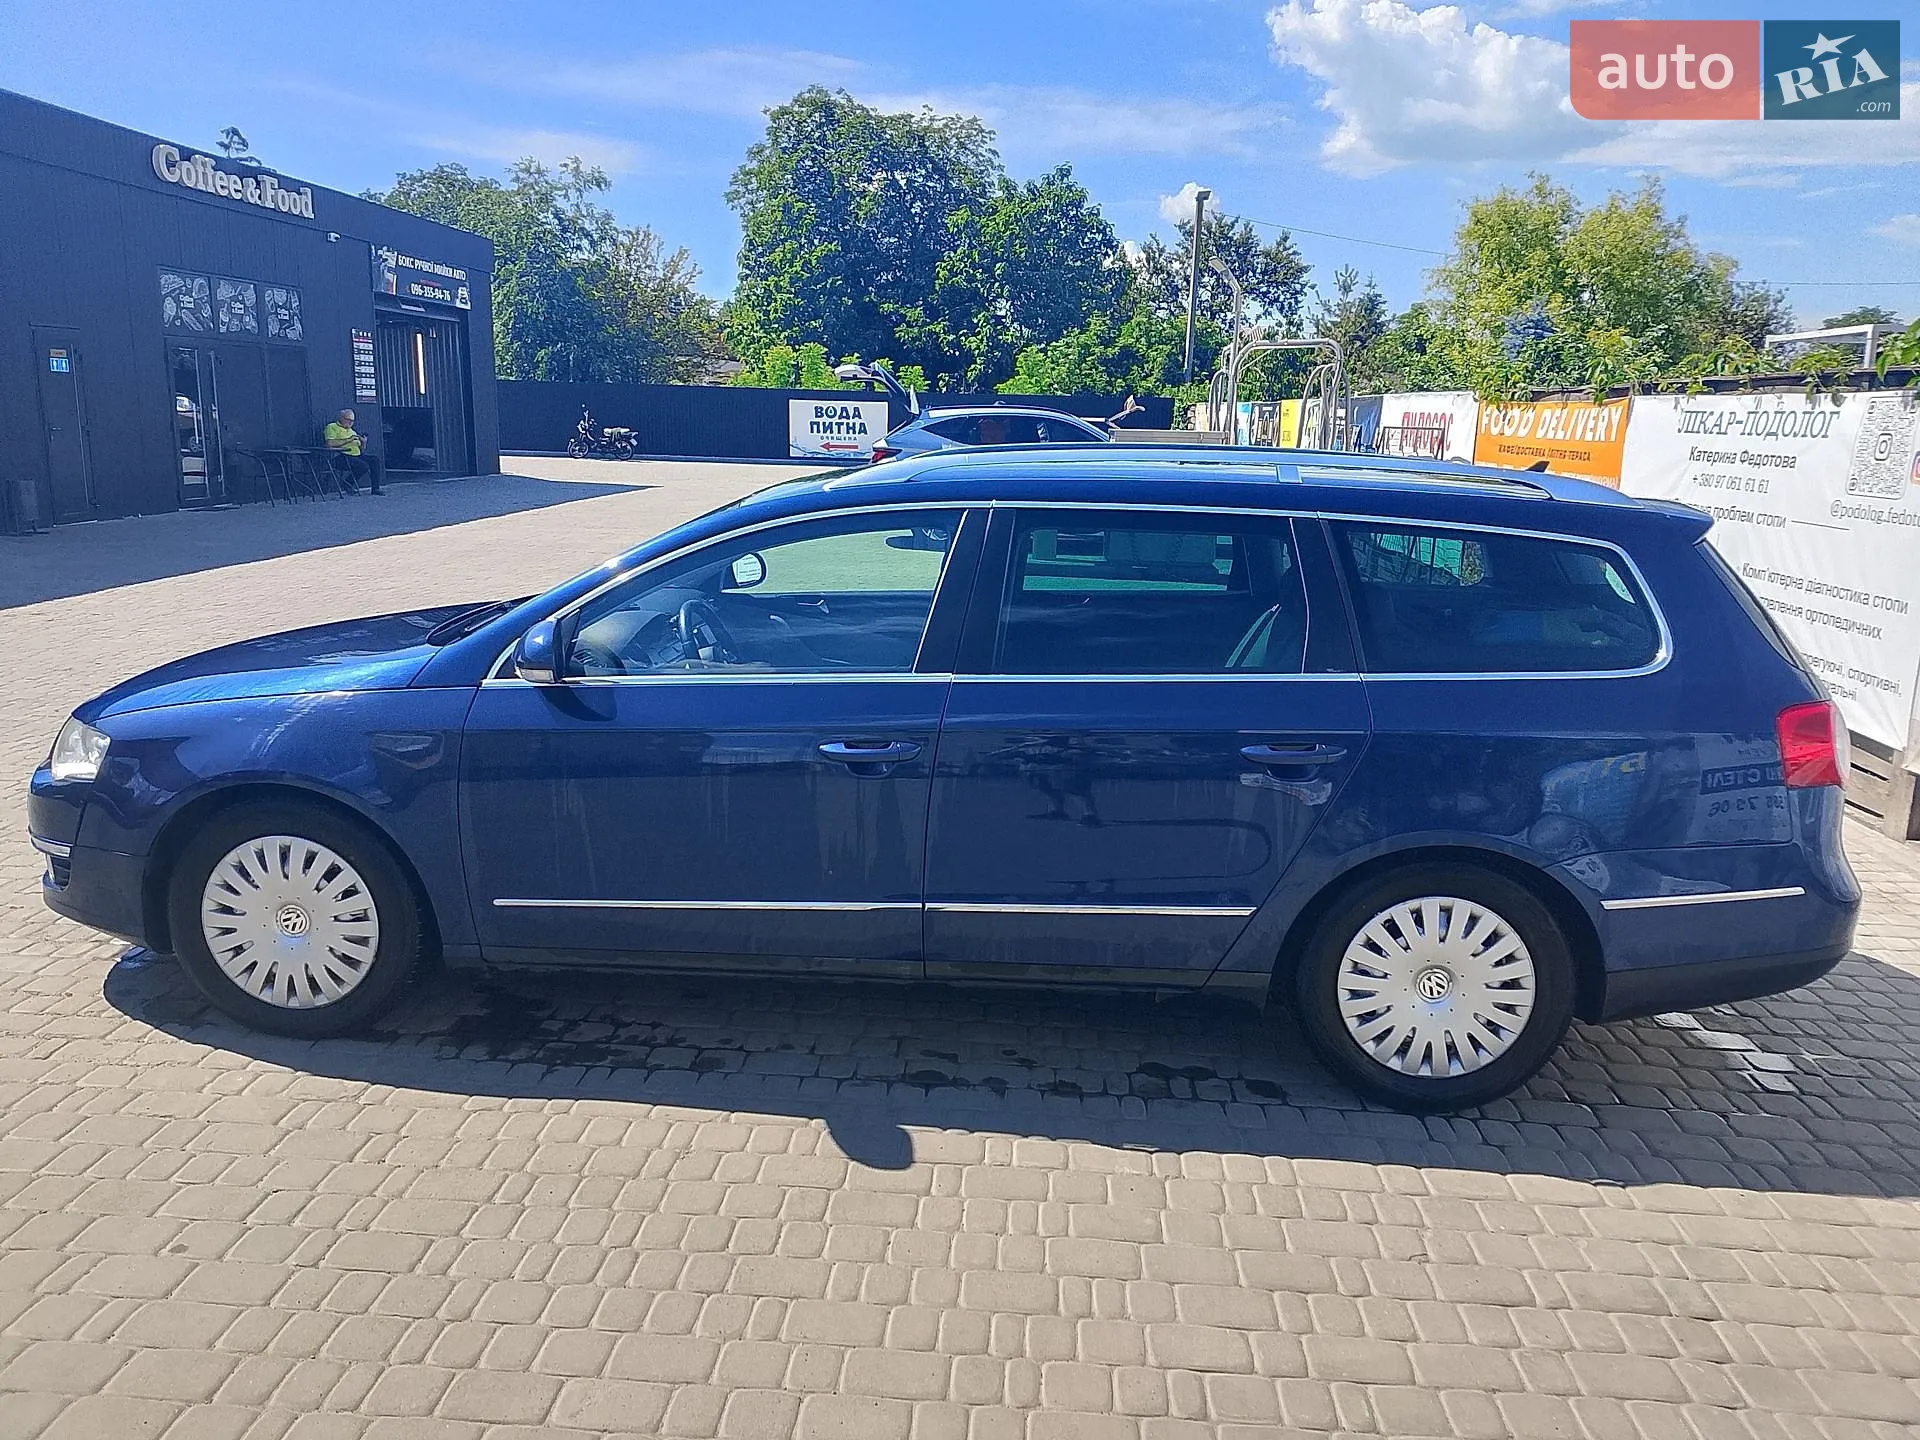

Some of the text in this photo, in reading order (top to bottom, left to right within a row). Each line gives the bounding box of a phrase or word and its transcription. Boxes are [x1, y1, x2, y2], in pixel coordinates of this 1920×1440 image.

[398, 254, 414, 268] БОКС
[813, 405, 862, 420] ВОДА
[1480, 405, 1624, 442] FOOD DELIVERY
[809, 421, 868, 435] ПИТНА
[1689, 446, 1797, 469] Катерина Федотова
[1745, 478, 1756, 492] 61
[1758, 479, 1769, 493] 61
[1713, 505, 1754, 523] проблем
[1757, 513, 1787, 528] стопи
[1805, 578, 1870, 605] діагностика
[1872, 594, 1909, 614] стопи
[1805, 609, 1883, 640] ортопедичних
